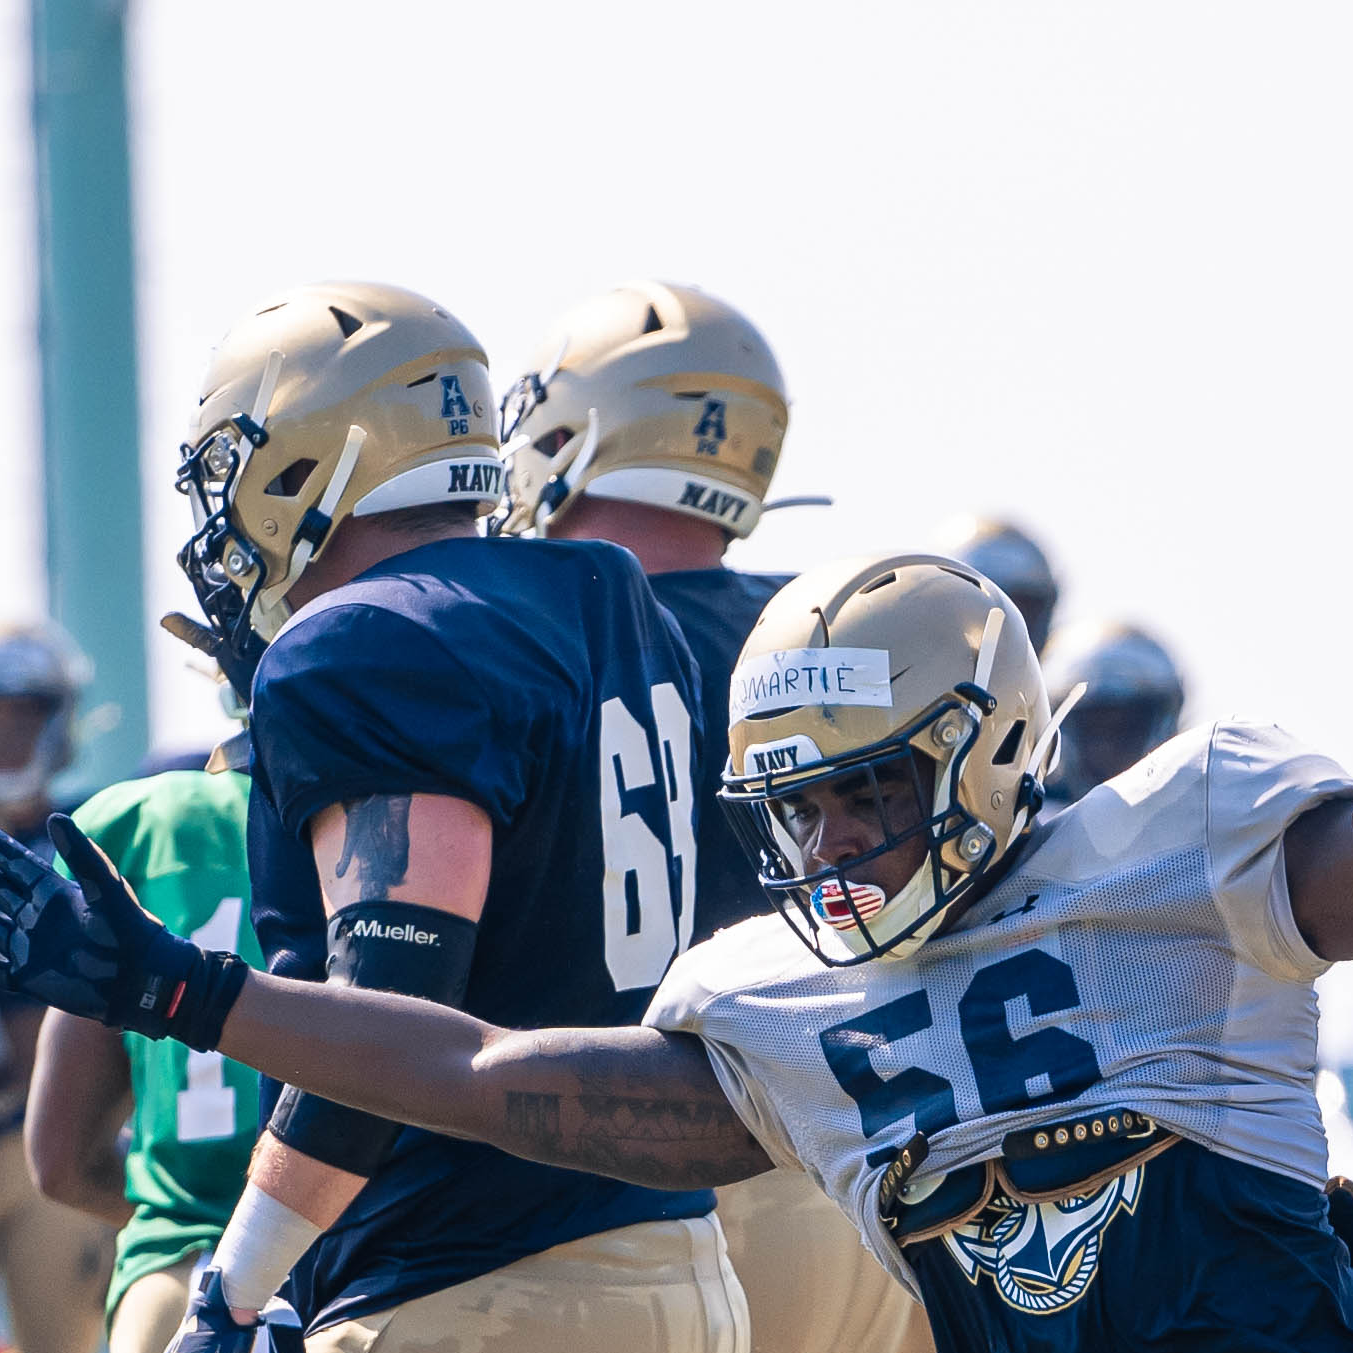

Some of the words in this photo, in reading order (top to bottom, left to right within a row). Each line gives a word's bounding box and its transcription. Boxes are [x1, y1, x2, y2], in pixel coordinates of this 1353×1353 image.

[448, 463, 502, 494] NAVY
[677, 481, 749, 522] NAVY
[753, 745, 798, 774] NAVY
[820, 948, 1104, 1140] 56
